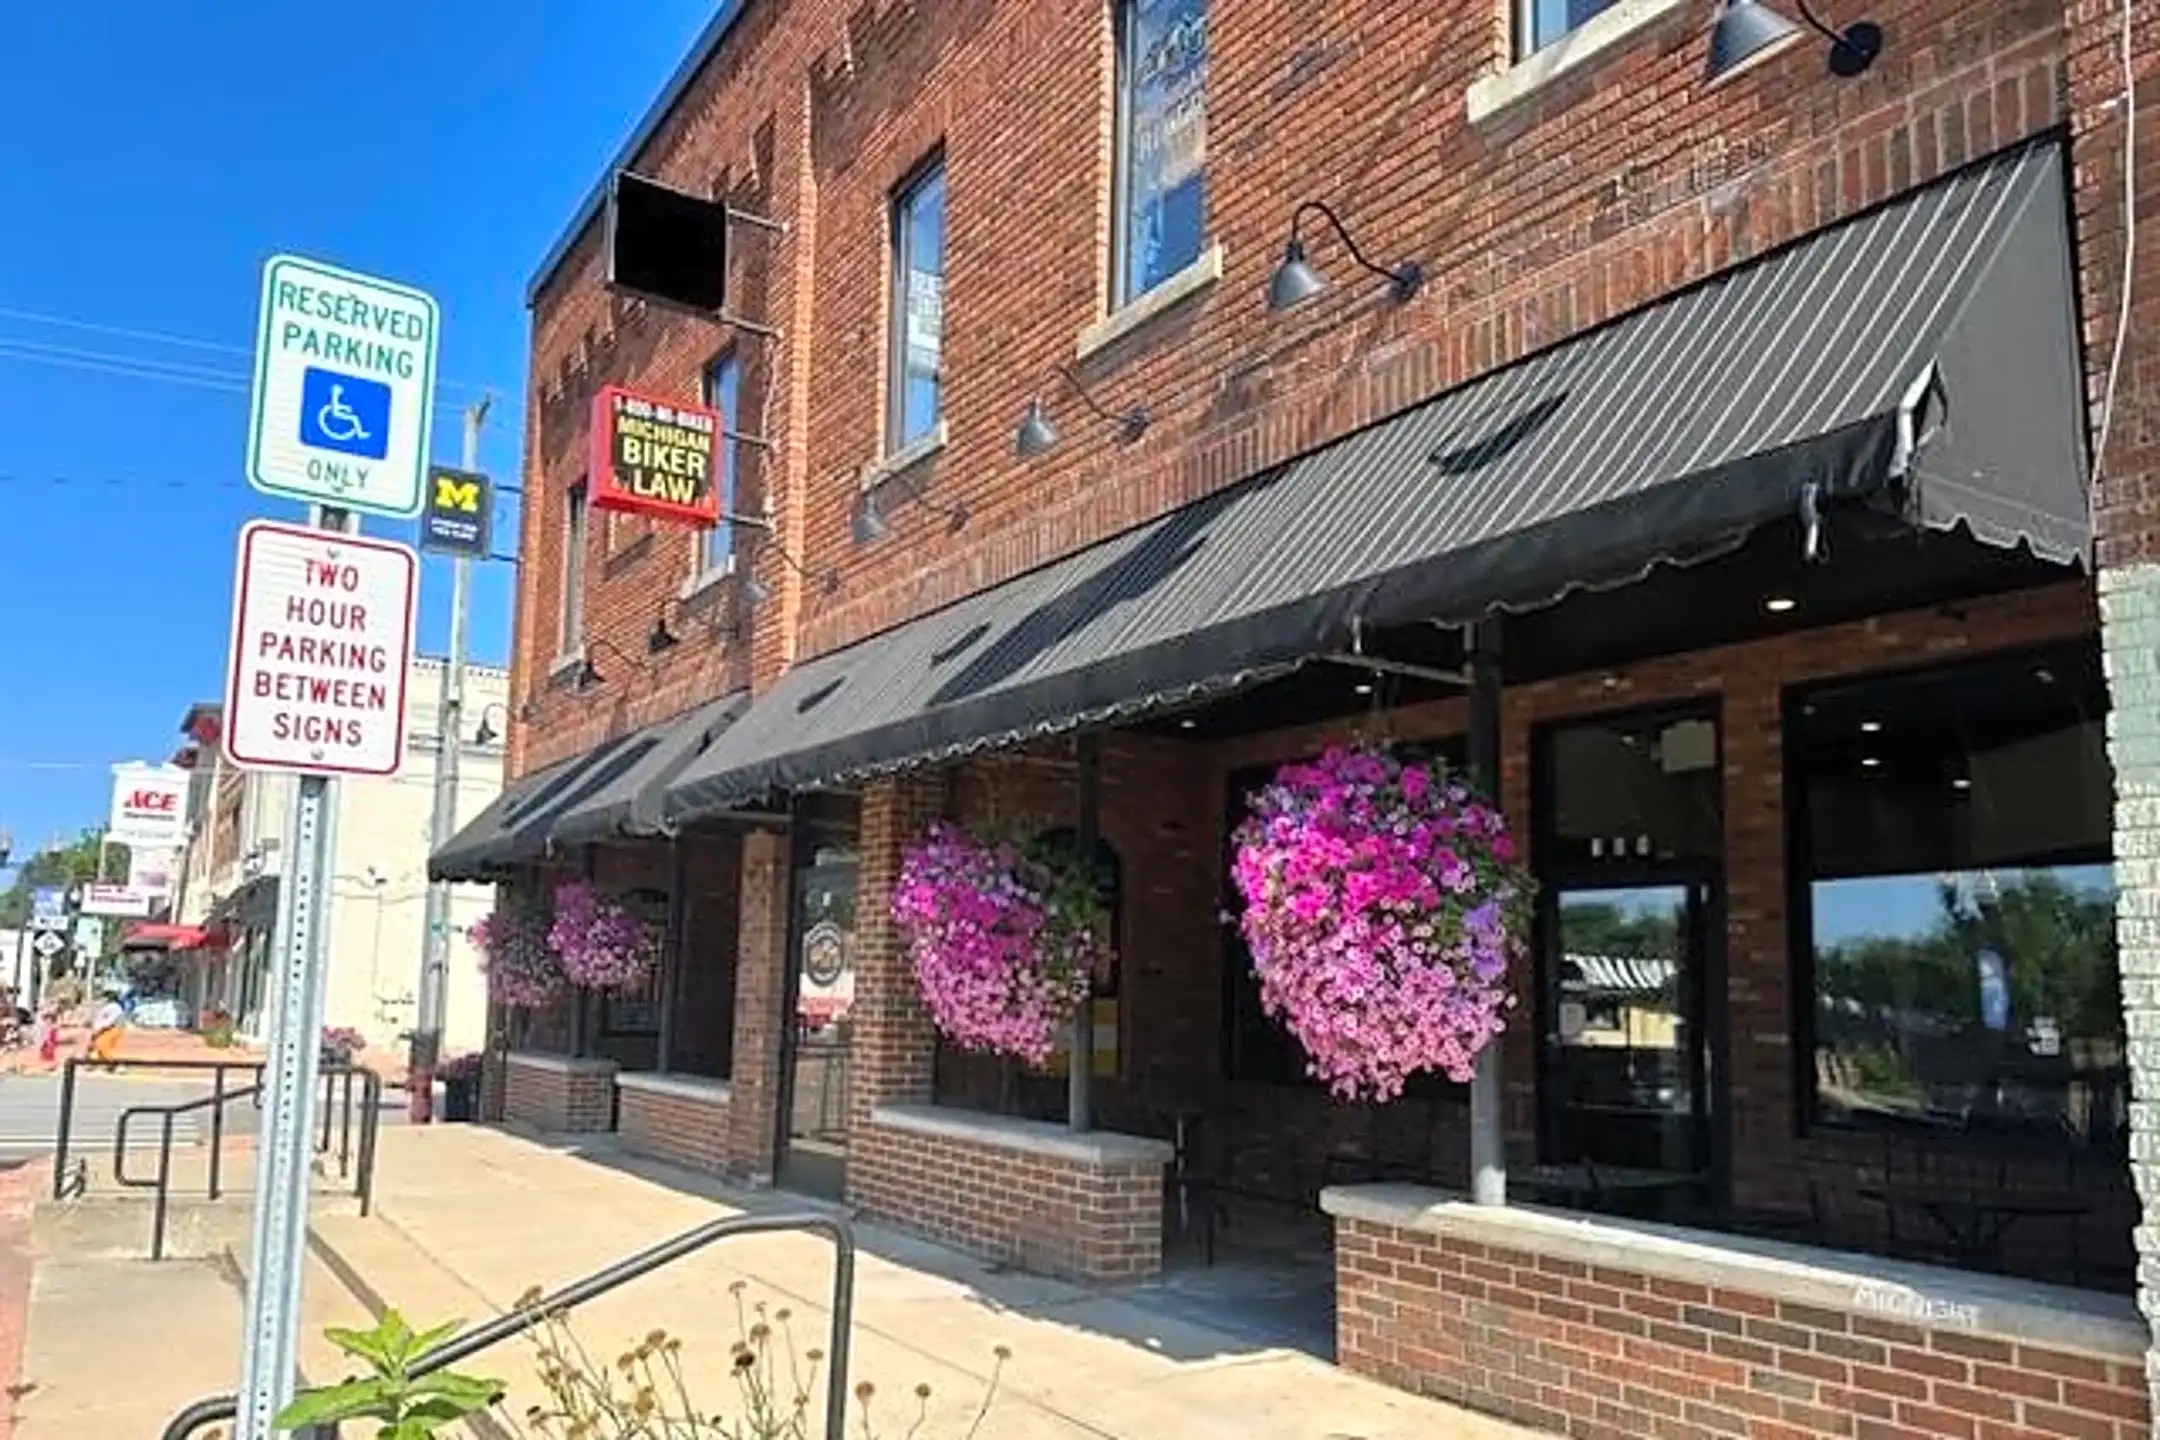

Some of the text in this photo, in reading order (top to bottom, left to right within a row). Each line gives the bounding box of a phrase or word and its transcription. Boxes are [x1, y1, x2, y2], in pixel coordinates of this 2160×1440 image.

[279, 280, 423, 341] RESERVED
[283, 321, 414, 379] PARKING
[617, 415, 710, 454] MICHIGAN
[306, 459, 370, 489] ONLY
[623, 436, 707, 478] BIKER
[435, 476, 480, 513] M
[633, 469, 696, 505] LAW
[304, 558, 359, 592] TWO
[287, 595, 367, 632] HOUR
[259, 631, 387, 673] PARKING
[253, 671, 387, 709] BETWEEN
[272, 712, 362, 747] SIGNS
[123, 789, 178, 811] ACE
